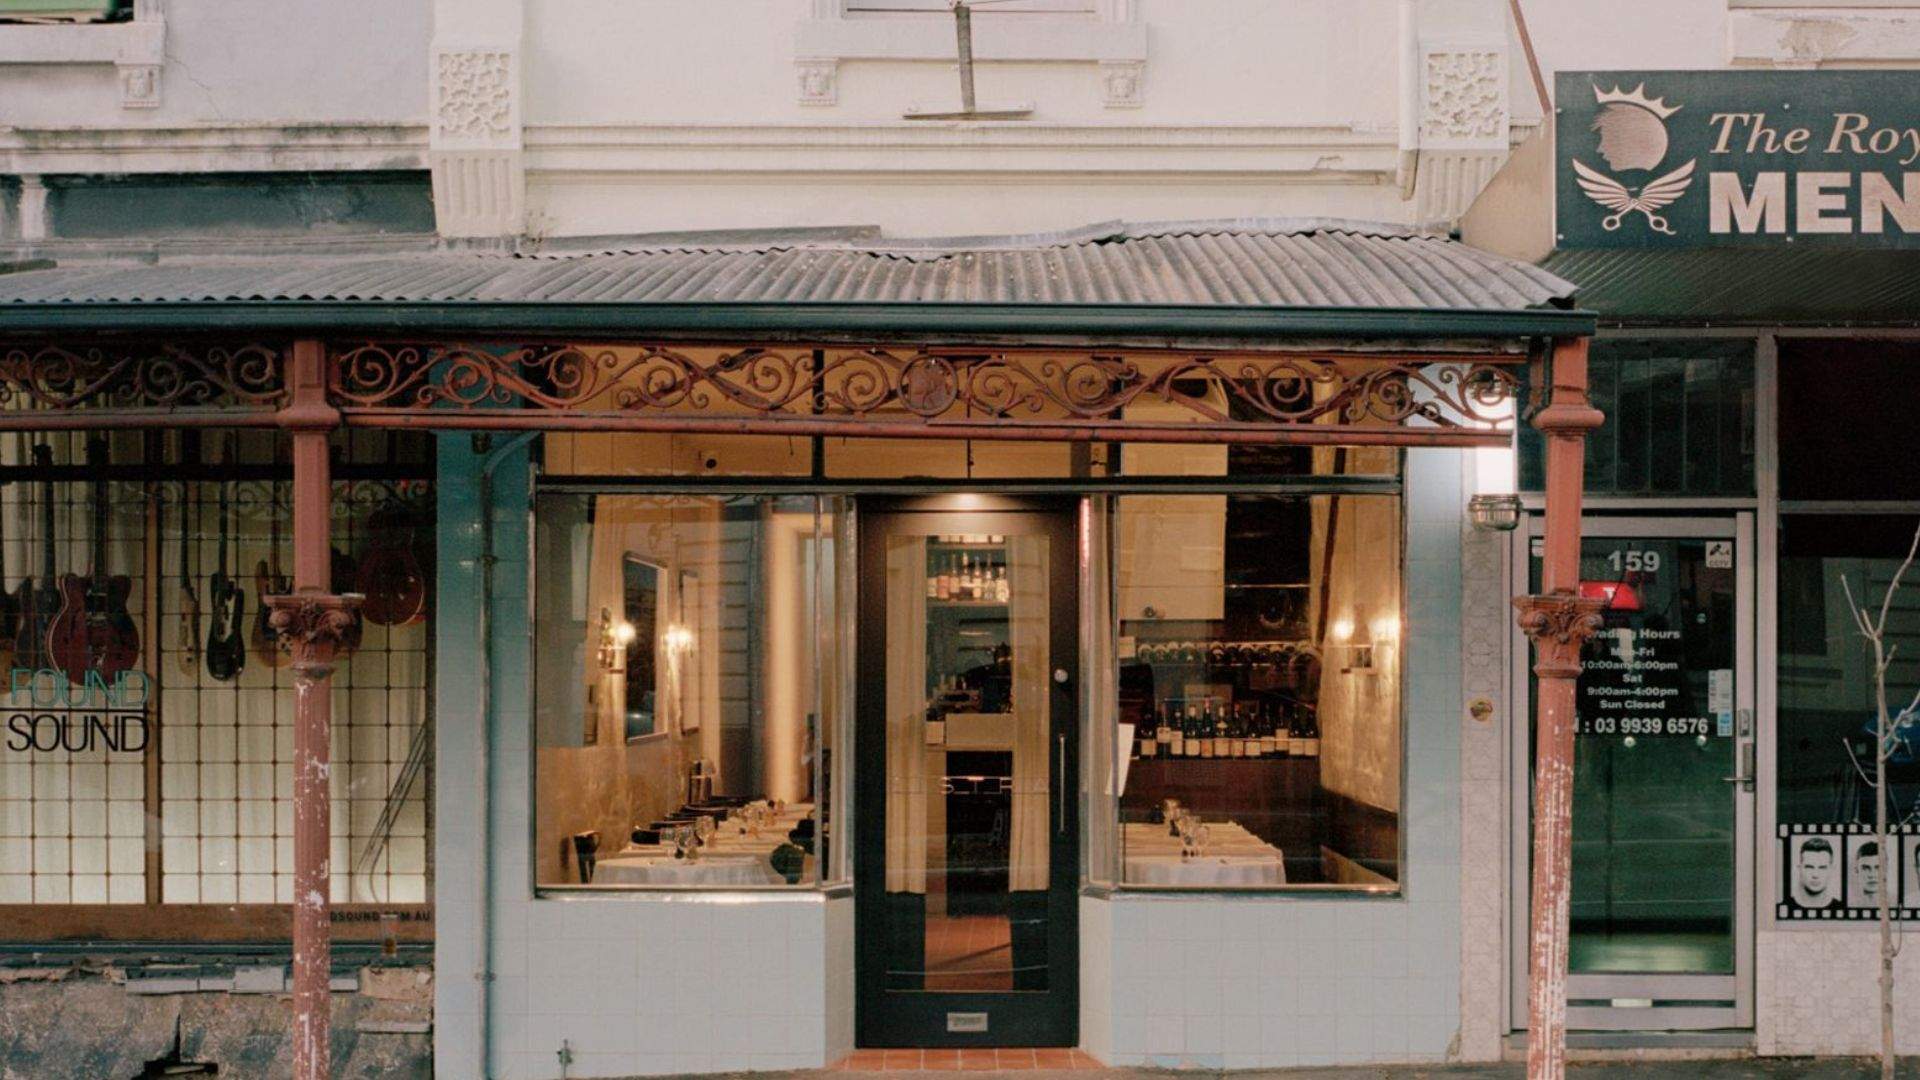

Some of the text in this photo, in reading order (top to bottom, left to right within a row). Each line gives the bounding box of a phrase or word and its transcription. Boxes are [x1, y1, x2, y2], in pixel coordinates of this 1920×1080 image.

[1709, 113, 1920, 165] The Roy
[1709, 171, 1920, 234] MEN
[1608, 550, 1660, 572] 159
[1640, 628, 1680, 639] Hours
[9, 667, 150, 707] FOUND
[1622, 673, 1643, 683] Sat
[1600, 699, 1666, 709] Sun Closed
[7, 713, 150, 752] SOUND
[1595, 718, 1616, 733] 03
[1620, 718, 1662, 733] 9939
[1666, 718, 1709, 733] 6576
